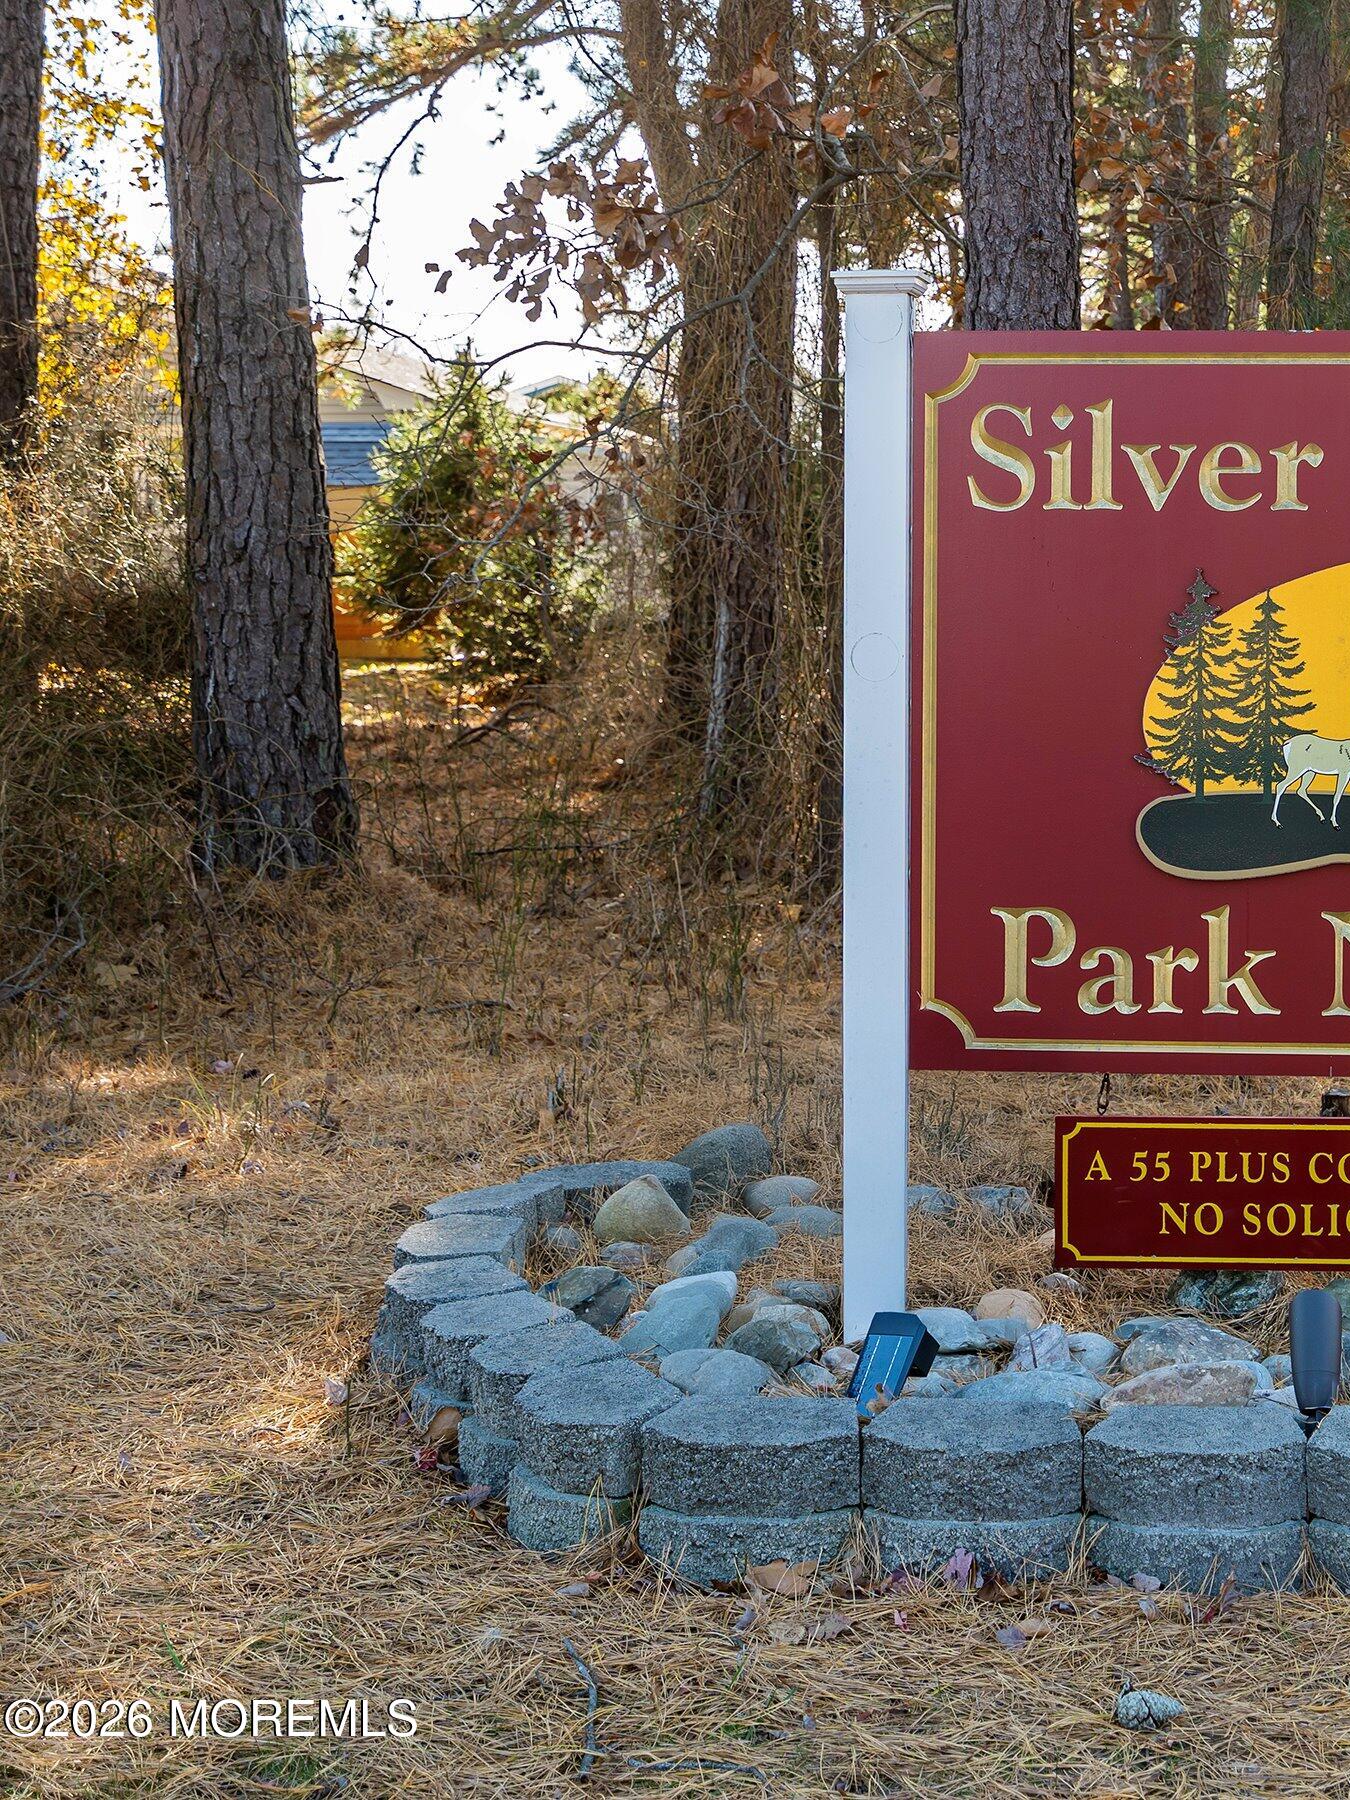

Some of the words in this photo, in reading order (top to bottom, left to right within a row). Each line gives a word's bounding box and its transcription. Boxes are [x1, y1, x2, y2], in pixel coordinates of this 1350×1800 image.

[966, 398, 1324, 513] Silver
[990, 904, 1282, 1018] Park
[1085, 1150, 1112, 1182] A
[1129, 1150, 1171, 1183] 55
[1189, 1151, 1291, 1184] PLUS
[1159, 1202, 1225, 1237] NO
